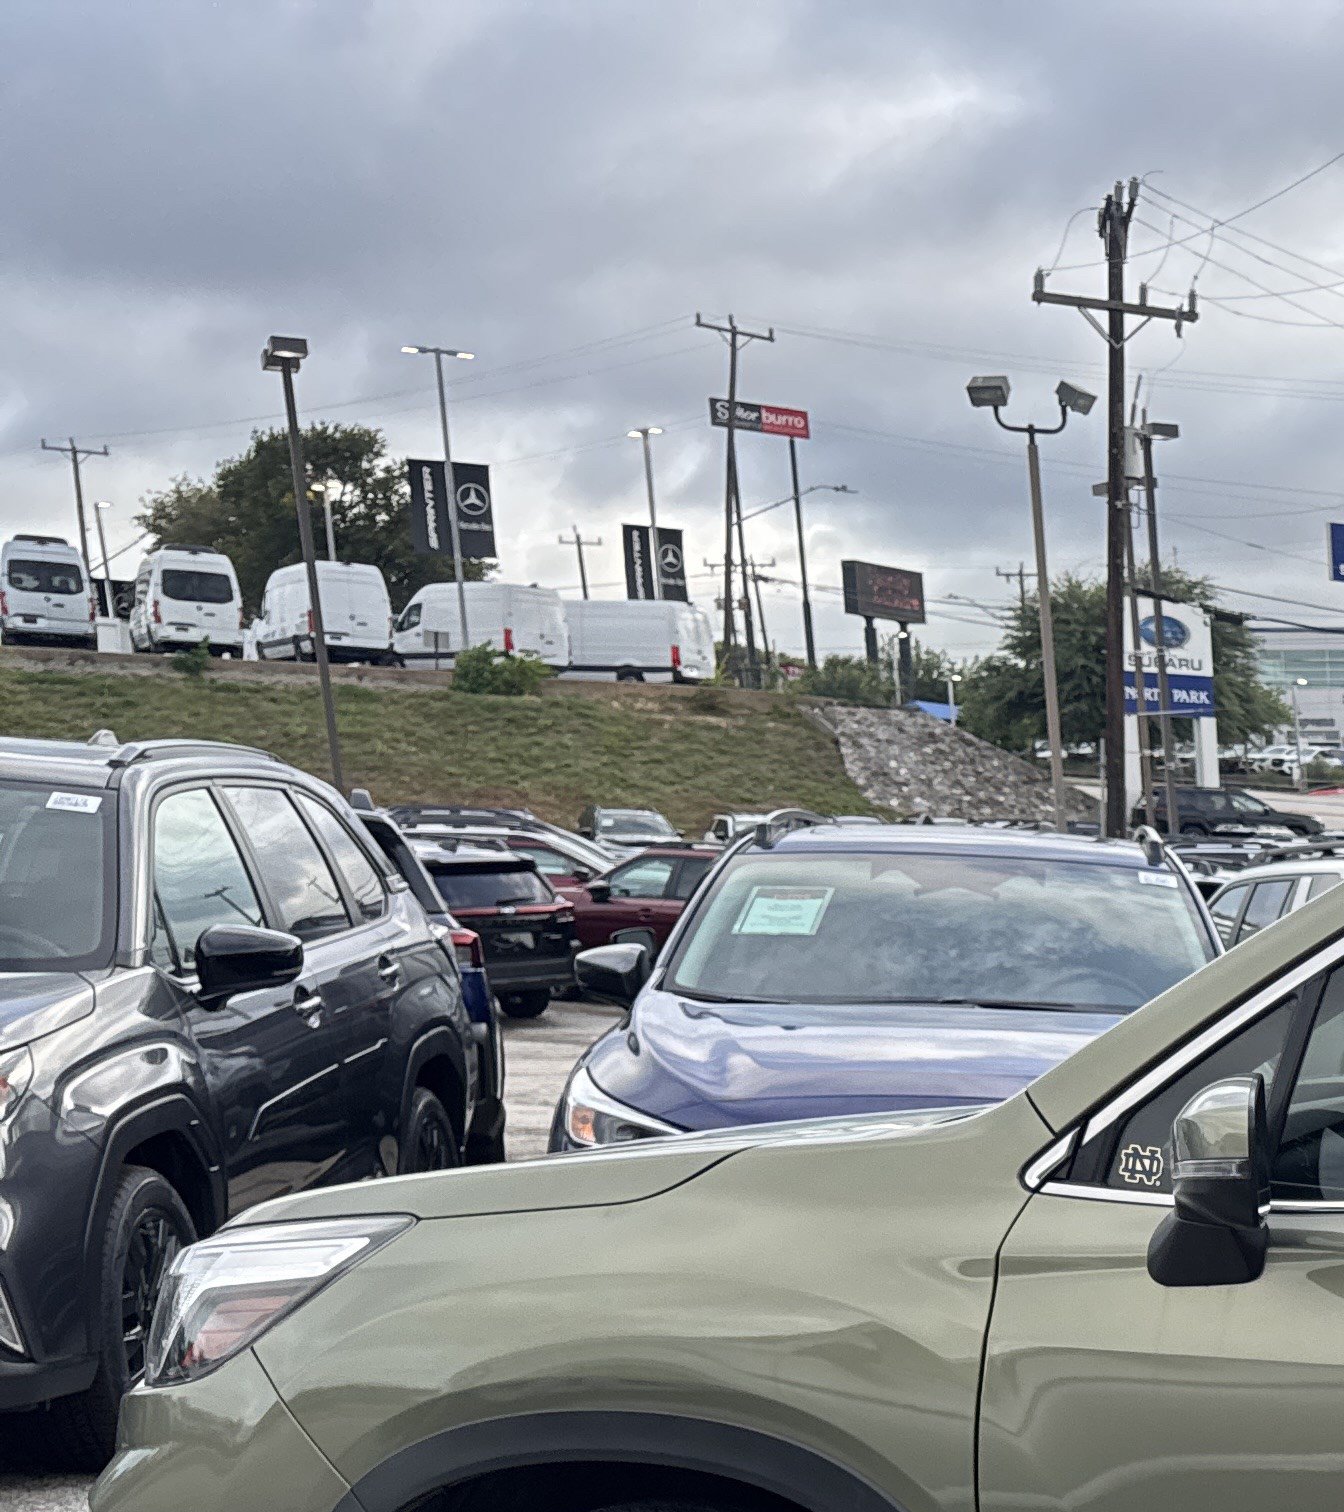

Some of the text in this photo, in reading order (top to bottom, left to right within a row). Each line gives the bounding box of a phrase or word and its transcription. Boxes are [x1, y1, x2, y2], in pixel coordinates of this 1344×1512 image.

[761, 409, 805, 429] burro
[1124, 686, 1211, 704] NRT PARK
